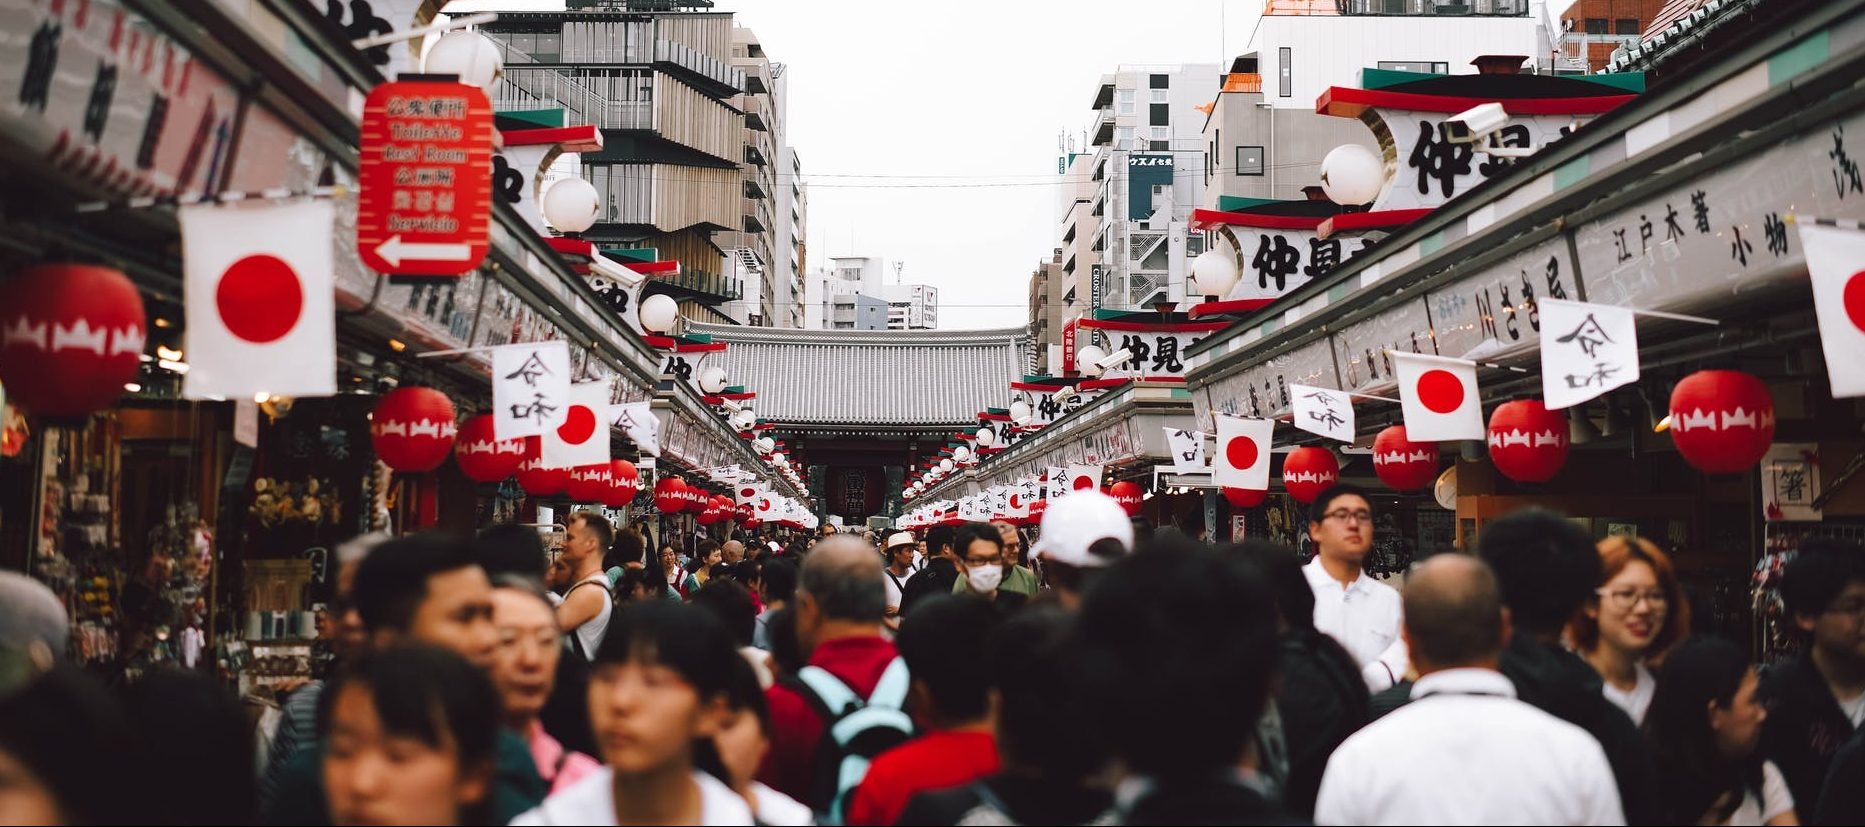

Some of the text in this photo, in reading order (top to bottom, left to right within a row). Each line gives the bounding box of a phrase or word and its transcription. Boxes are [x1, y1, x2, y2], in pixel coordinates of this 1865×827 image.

[425, 147, 467, 162] Room
[1252, 234, 1380, 292] 仲見
[1732, 211, 1788, 267] 小物
[1555, 313, 1622, 389] 令和
[505, 352, 558, 426] 令和
[1303, 391, 1345, 432] 令和
